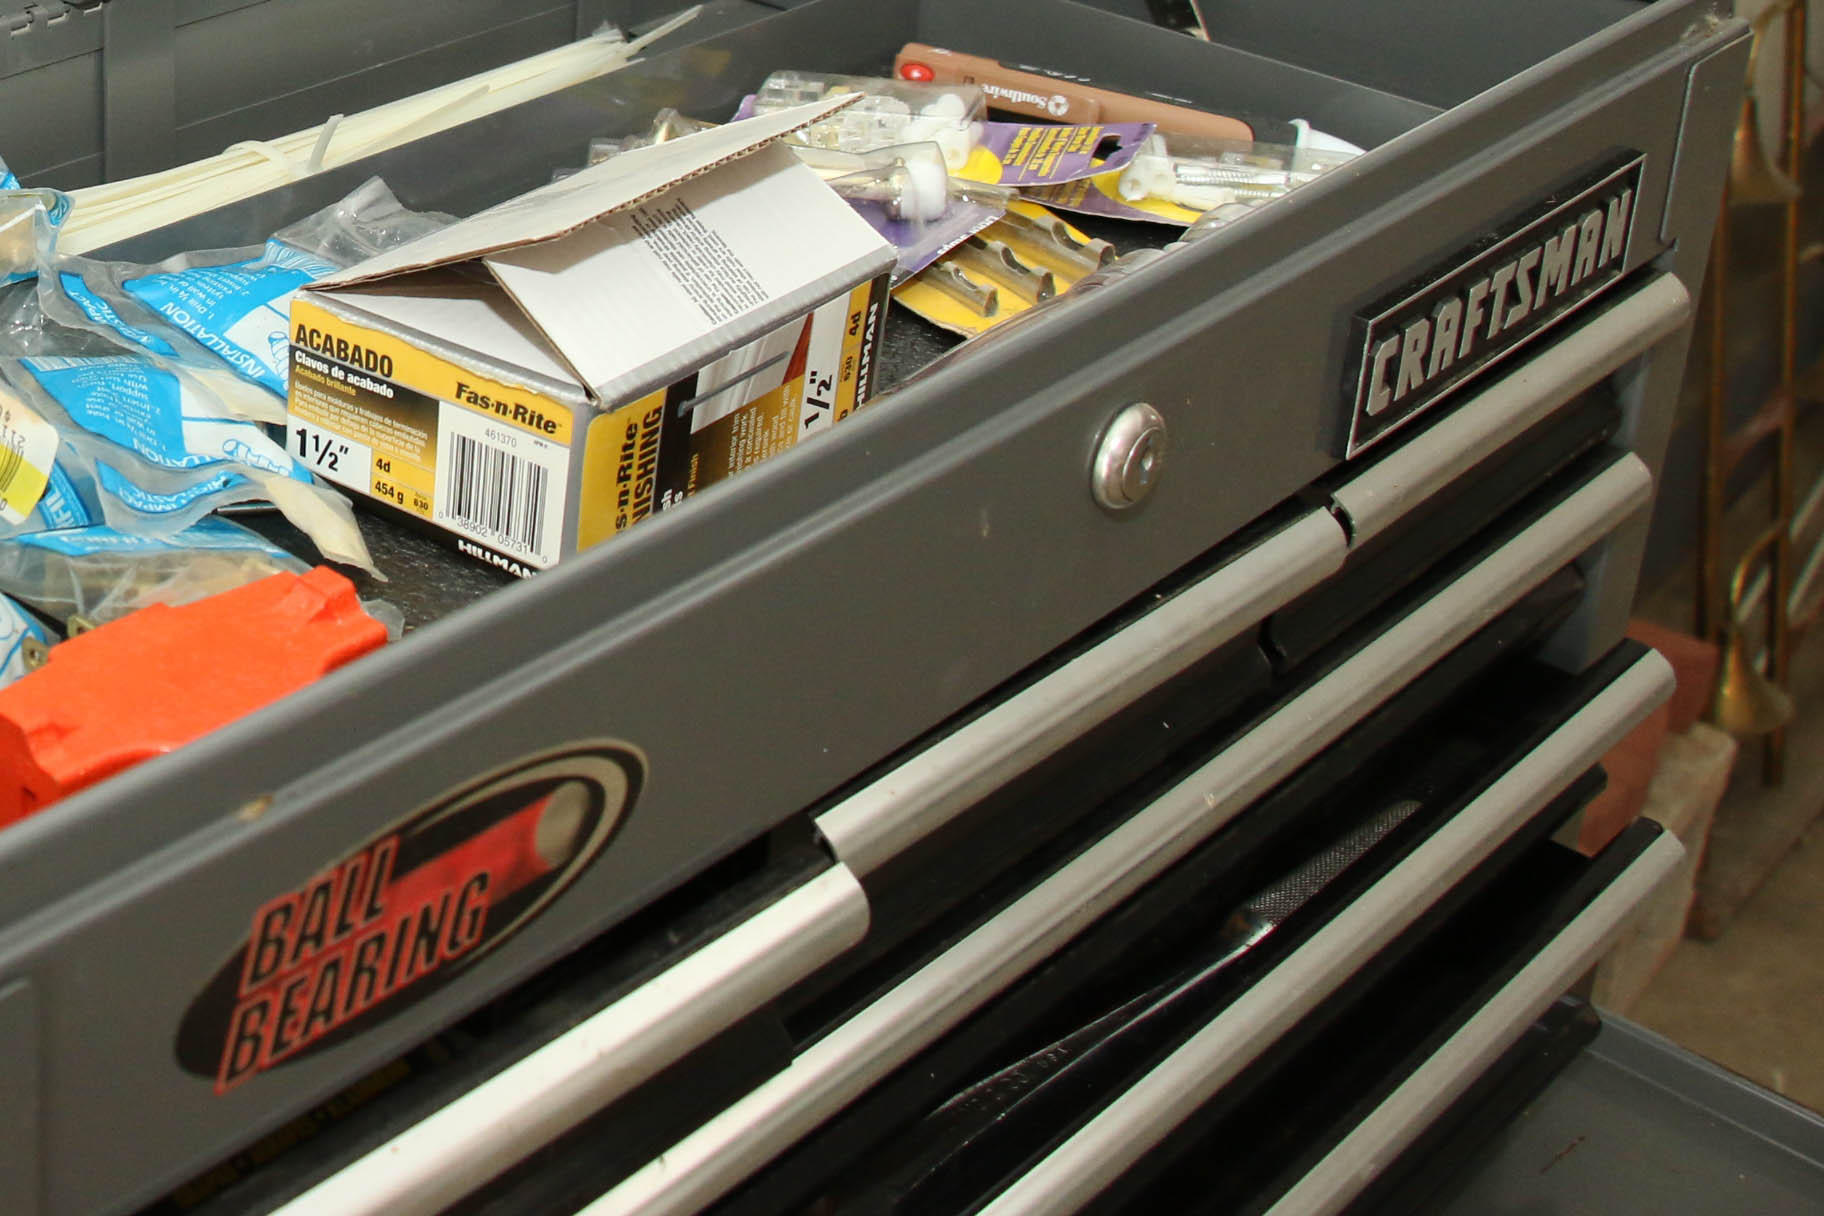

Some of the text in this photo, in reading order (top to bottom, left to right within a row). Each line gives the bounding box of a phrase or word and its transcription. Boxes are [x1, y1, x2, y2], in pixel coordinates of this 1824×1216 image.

[848, 310, 862, 337] 4d
[1366, 187, 1633, 416] CRAFTSMAN
[160, 302, 266, 378] INSTALLATION
[295, 324, 393, 378] ACABADO
[856, 302, 879, 410] HILLMAN
[295, 350, 394, 399] Clavos de acabado
[484, 427, 517, 449] 461370
[375, 458, 391, 473] 4d
[375, 480, 395, 498] 454
[397, 491, 404, 505] g
[631, 405, 663, 526] NISHING
[457, 516, 488, 538] 38902
[497, 534, 529, 552] 05731
[242, 837, 399, 993] BALL
[220, 868, 493, 1088] BEARING
